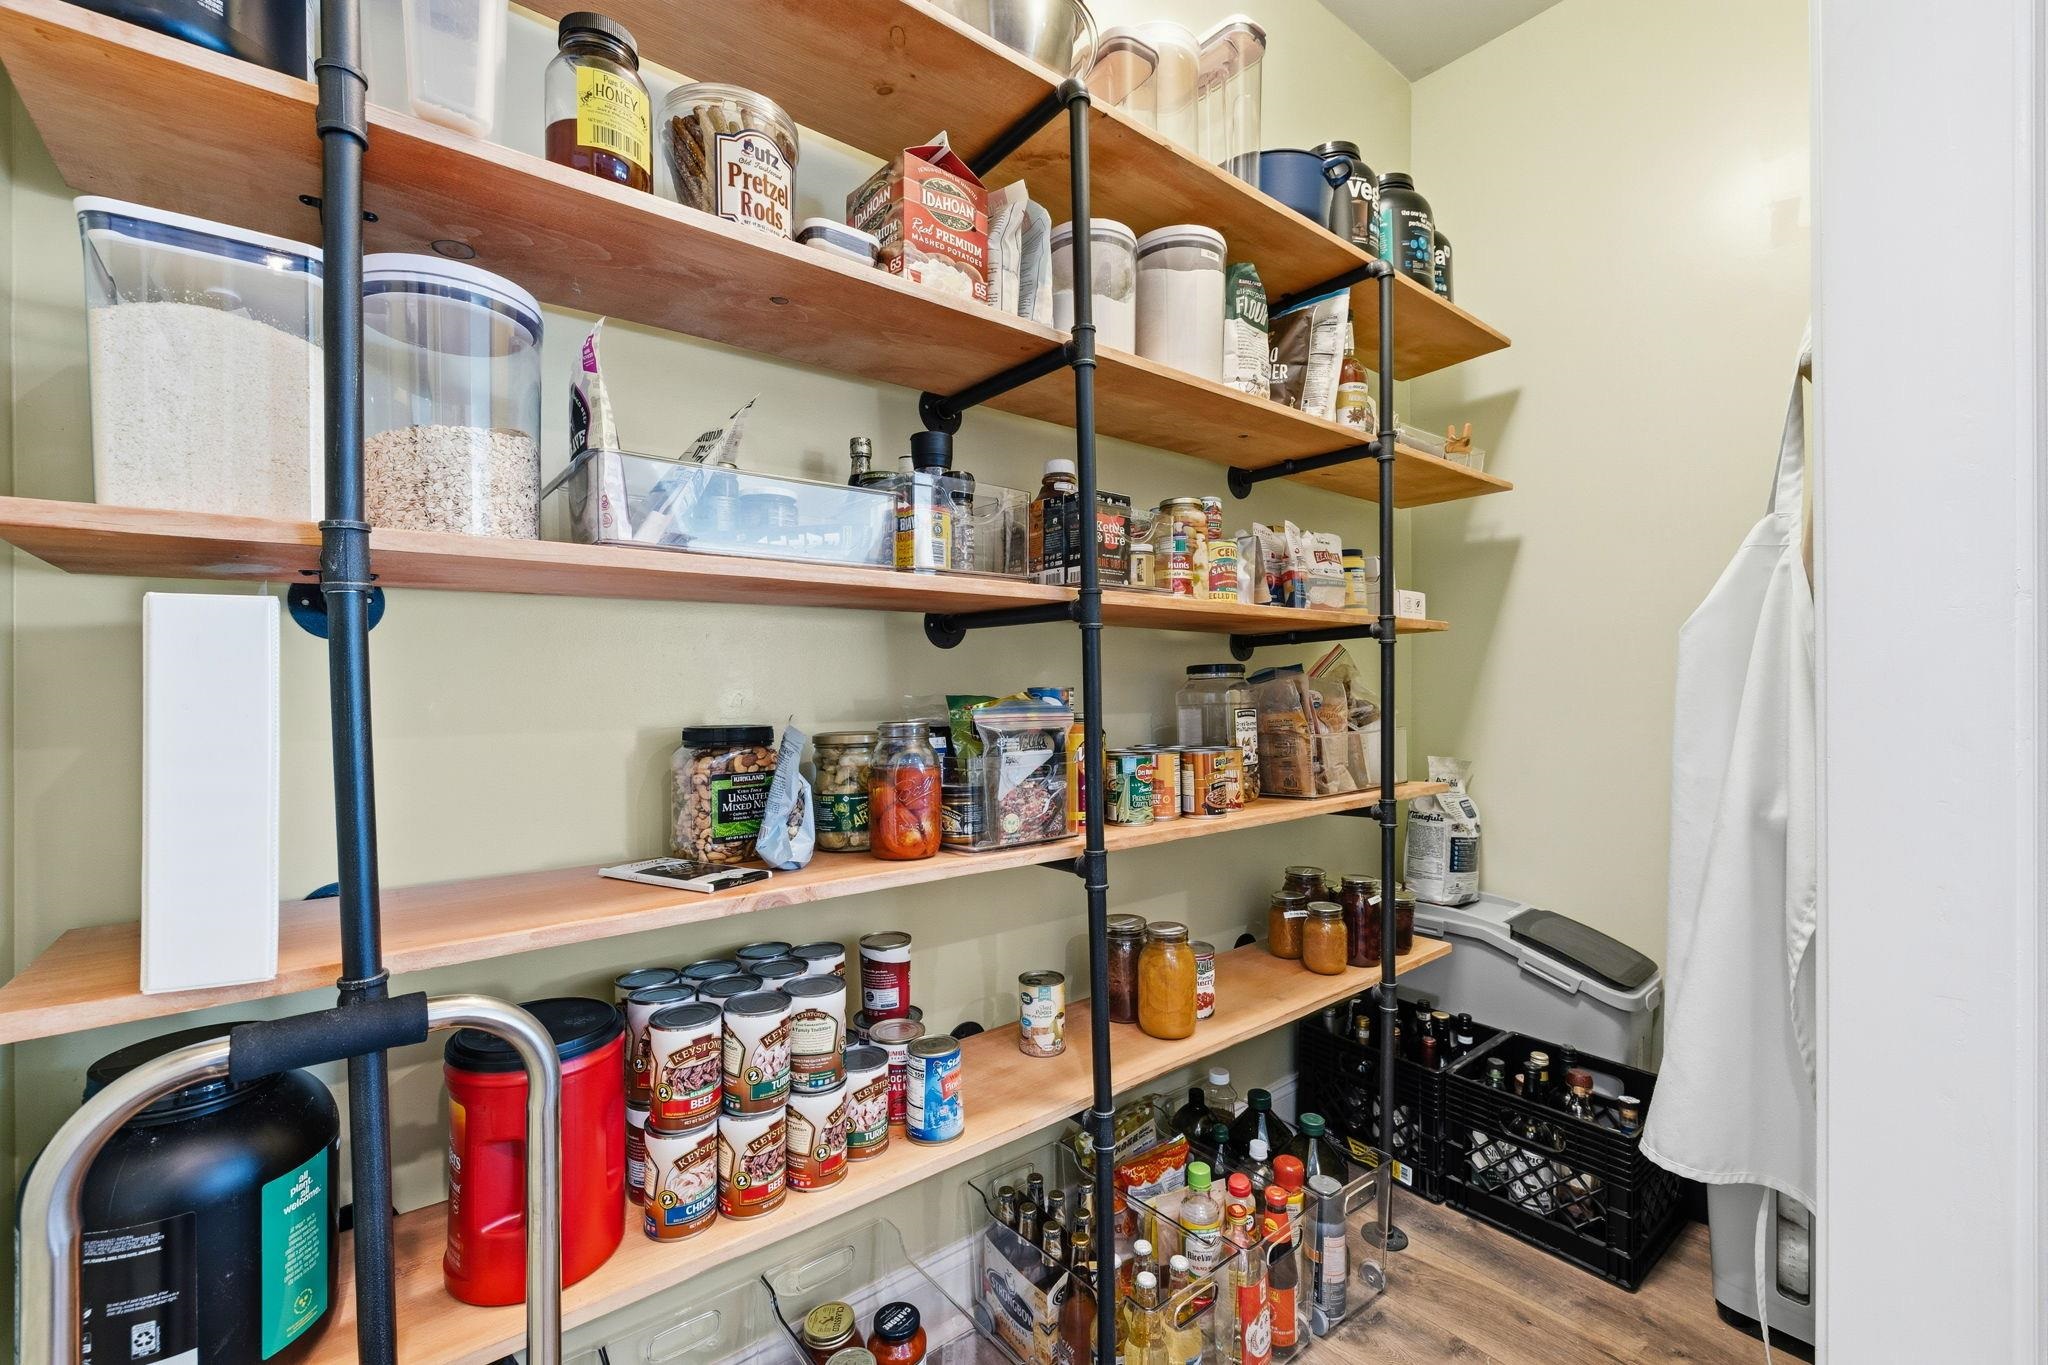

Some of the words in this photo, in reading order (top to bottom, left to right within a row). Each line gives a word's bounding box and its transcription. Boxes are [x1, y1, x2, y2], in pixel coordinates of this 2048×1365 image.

[595, 83, 638, 112] HONEY
[755, 147, 780, 171] utz
[728, 162, 789, 210] Pretzel
[740, 191, 783, 230] Rods
[854, 186, 891, 229] IDAHOAN
[921, 188, 975, 221] IDAHOAN
[912, 217, 934, 235] Real
[936, 228, 983, 258] PREMIUM
[912, 233, 945, 250] MASHED
[947, 246, 983, 268] POTATOES
[890, 256, 902, 271] 65
[974, 282, 987, 297] 65
[1097, 521, 1125, 535] Kettle
[1104, 534, 1126, 545] Fire
[733, 774, 765, 783] KIRKLAND
[722, 802, 752, 812] MIXED
[750, 1071, 758, 1081] 2
[660, 1088, 668, 1098] 2
[690, 1093, 713, 1109] BEEF
[818, 1149, 825, 1157] 2
[299, 1170, 309, 1183] all
[738, 1176, 746, 1185] 2
[290, 1176, 313, 1198] plant.
[300, 1185, 309, 1198] all
[283, 1186, 322, 1215] welcome.
[663, 1195, 672, 1205] 2
[991, 1276, 1033, 1326] STRONGBOW
[831, 1306, 845, 1332] CLASSICO
[882, 1306, 912, 1331] CARBONE
